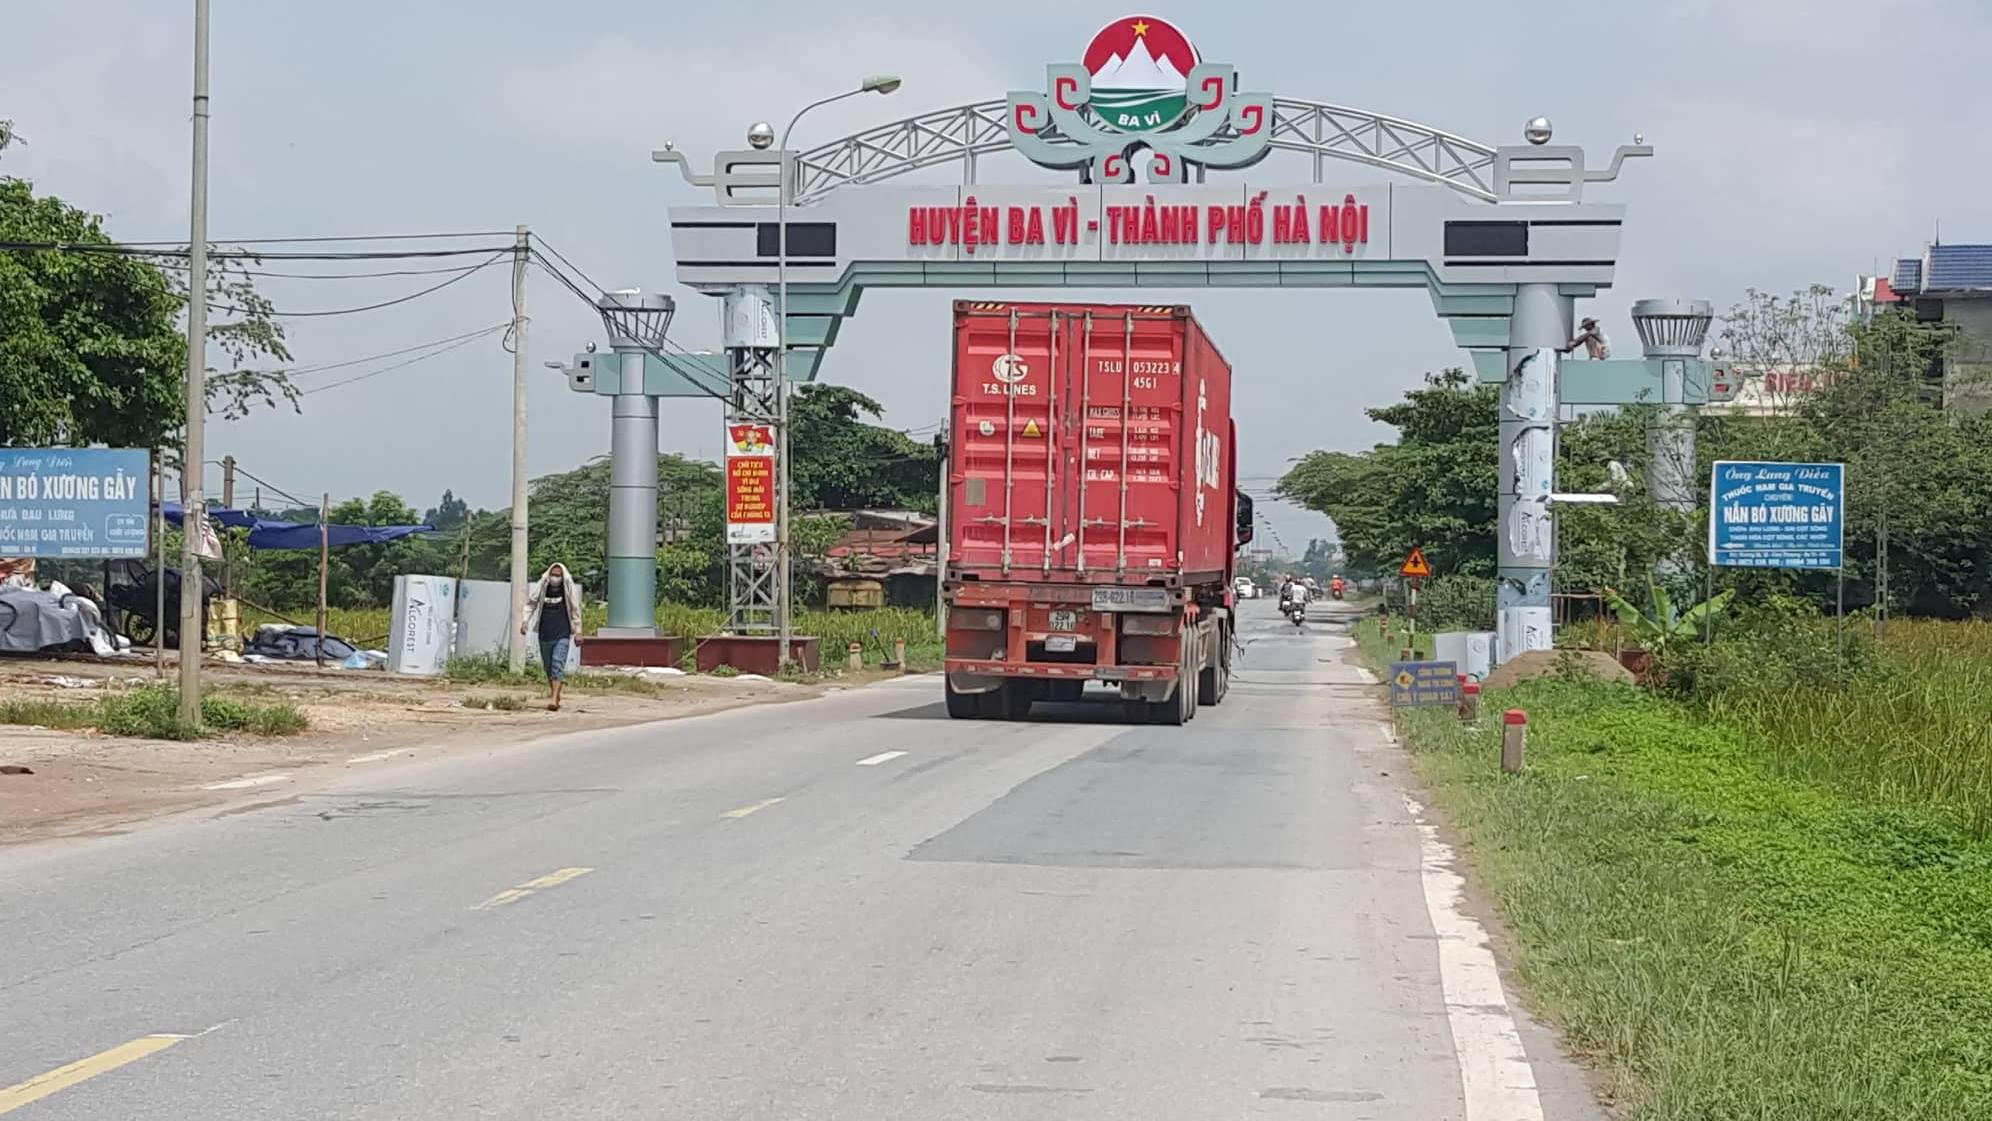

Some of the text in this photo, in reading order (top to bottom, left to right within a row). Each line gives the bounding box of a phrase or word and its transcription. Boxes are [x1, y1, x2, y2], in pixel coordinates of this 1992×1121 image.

[1118, 113, 1140, 127] BA
[909, 196, 999, 254] HUYỆN
[1008, 205, 1045, 245] BA
[1052, 196, 1078, 245] VÌ
[1106, 194, 1198, 245] THÀNH
[1207, 191, 1268, 245] PHỐ
[1273, 194, 1310, 244] HÀ
[1319, 194, 1368, 254] NỘI
[1098, 361, 1122, 373] TSLU
[1133, 361, 1169, 374] 053223
[1003, 384, 1037, 395] LNES
[17, 472, 38, 500] BÓ
[43, 474, 98, 500] XƯƠNG
[1778, 483, 1794, 491] GIA
[1751, 502, 1767, 523] BÓ
[1769, 504, 1808, 523] XƯƠNG
[406, 597, 425, 652] ALCOREST
